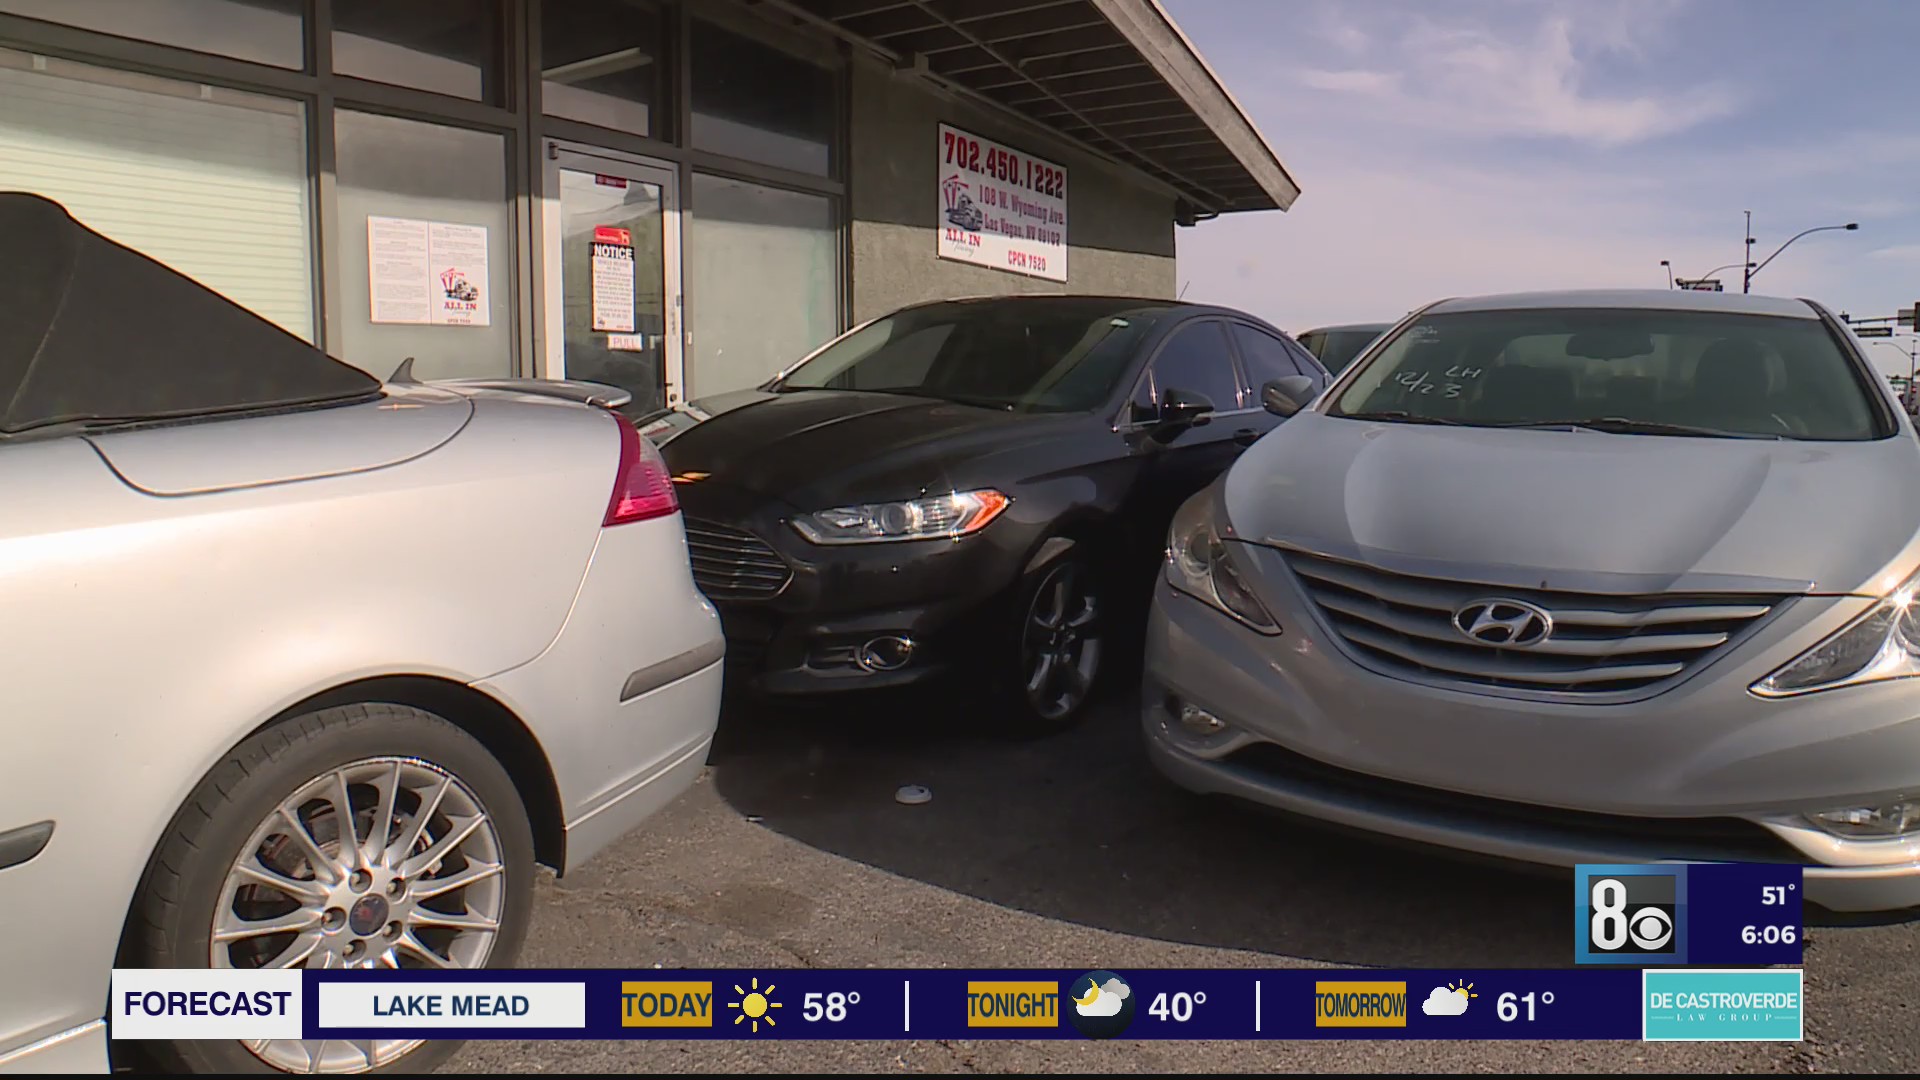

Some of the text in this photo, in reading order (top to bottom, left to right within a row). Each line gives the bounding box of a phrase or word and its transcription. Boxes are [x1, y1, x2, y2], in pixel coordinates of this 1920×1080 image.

[944, 131, 1063, 199] 702.450.1222
[979, 184, 1065, 225] 108 W. Wyoming Ave.
[945, 228, 980, 247] ALL IN
[984, 213, 998, 232] Las
[1001, 218, 1024, 239] Vegas,
[1026, 225, 1036, 240] NV
[594, 244, 633, 260] NOTICE
[1008, 250, 1046, 272] CPCN 7520
[444, 302, 477, 311] ALL IN
